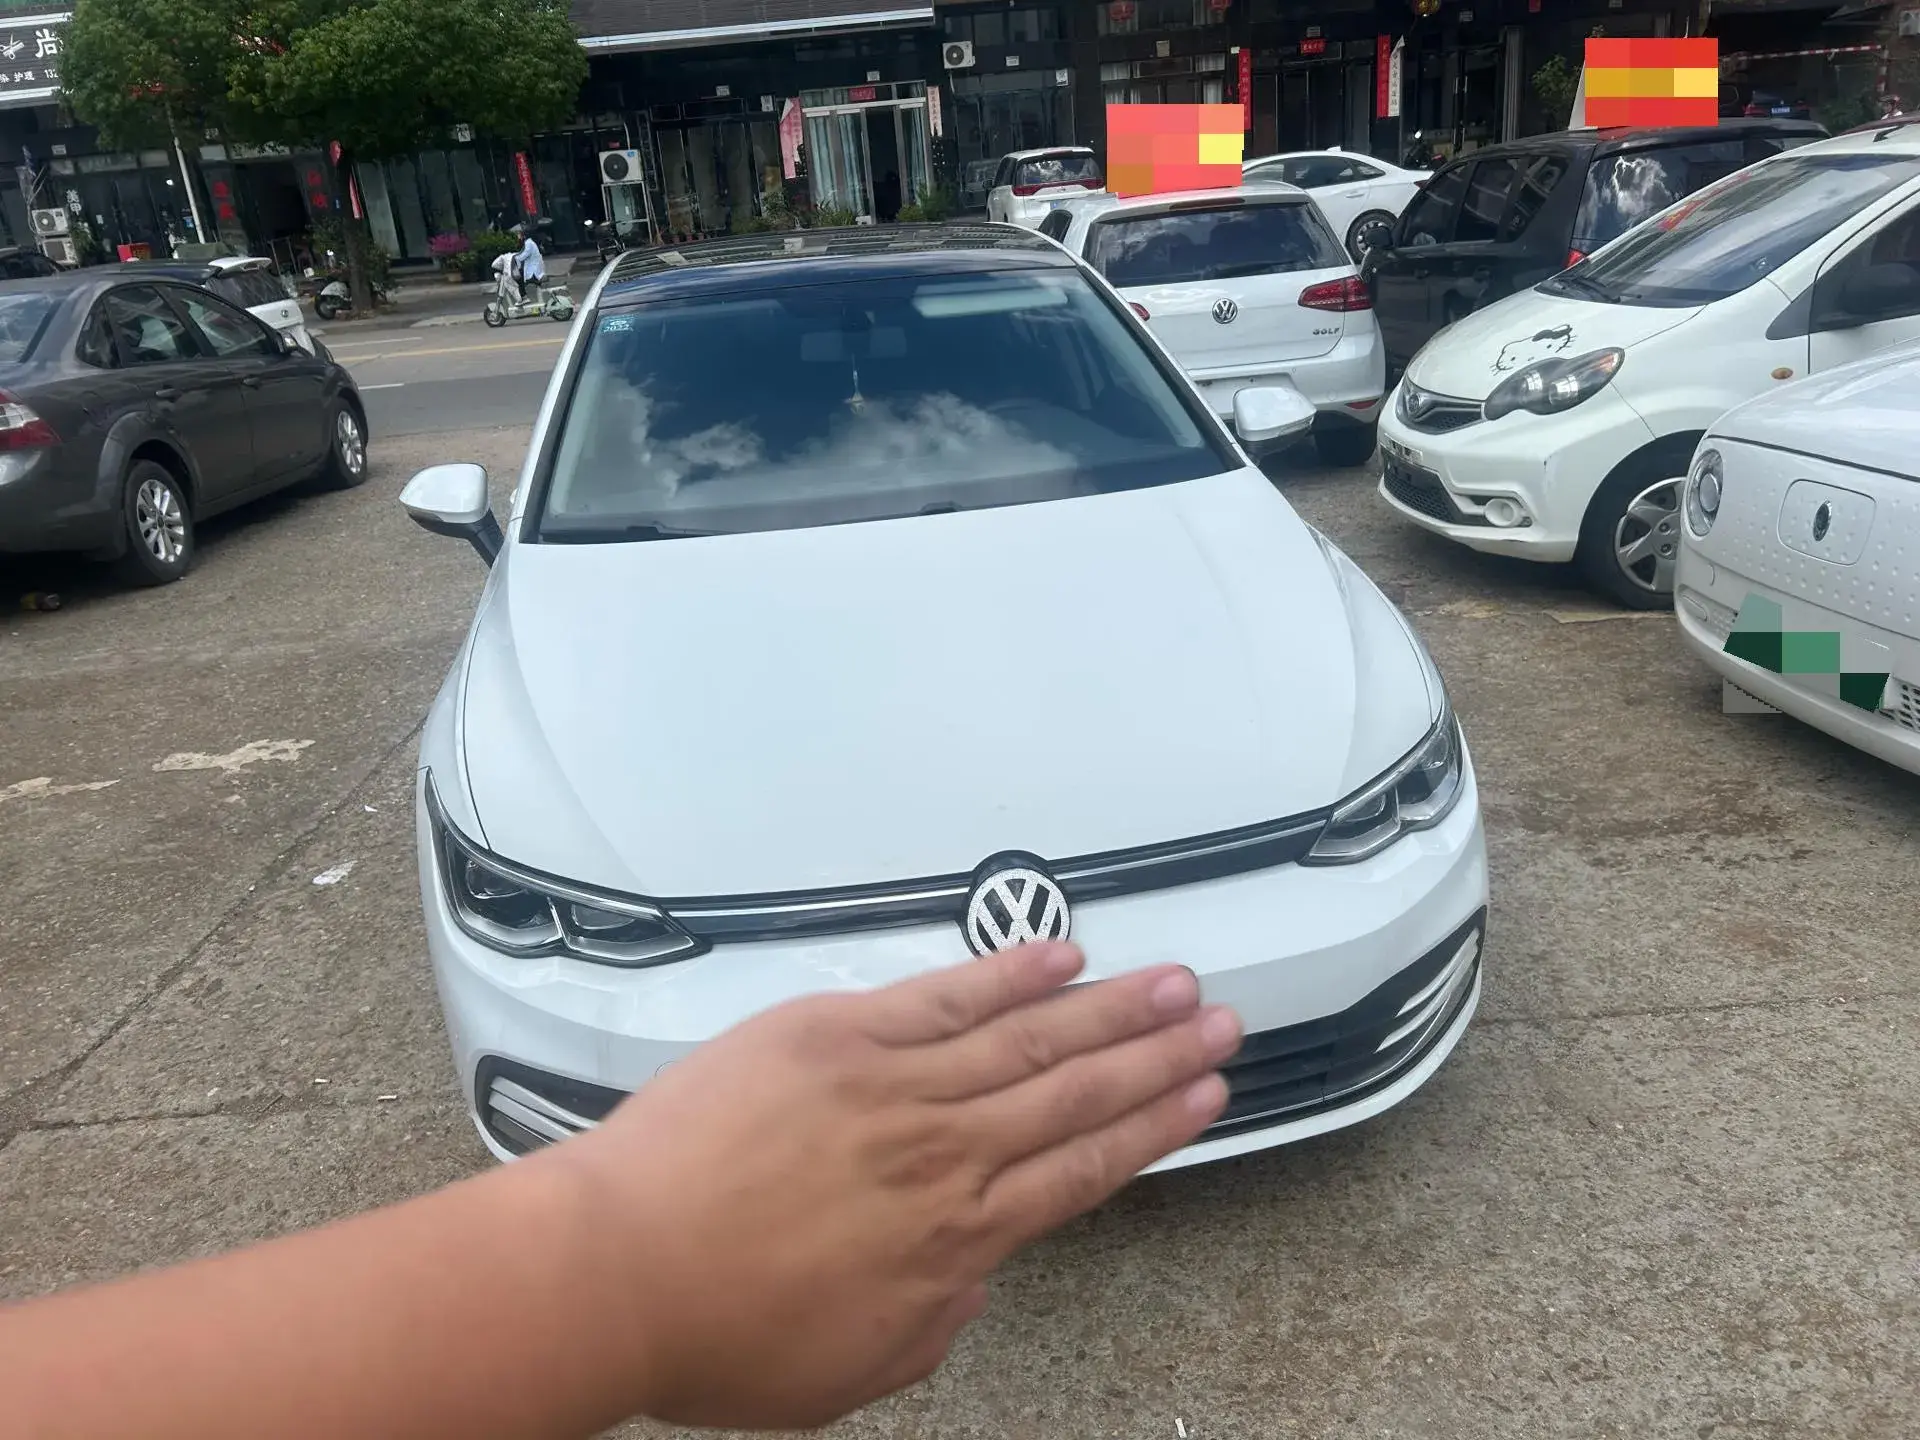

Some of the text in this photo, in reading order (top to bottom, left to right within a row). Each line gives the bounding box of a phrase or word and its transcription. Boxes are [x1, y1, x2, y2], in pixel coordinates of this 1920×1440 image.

[35, 28, 64, 58] 尚
[14, 70, 35, 82] 护理
[65, 188, 83, 215] 美甲
[1312, 327, 1340, 336] GOLF
